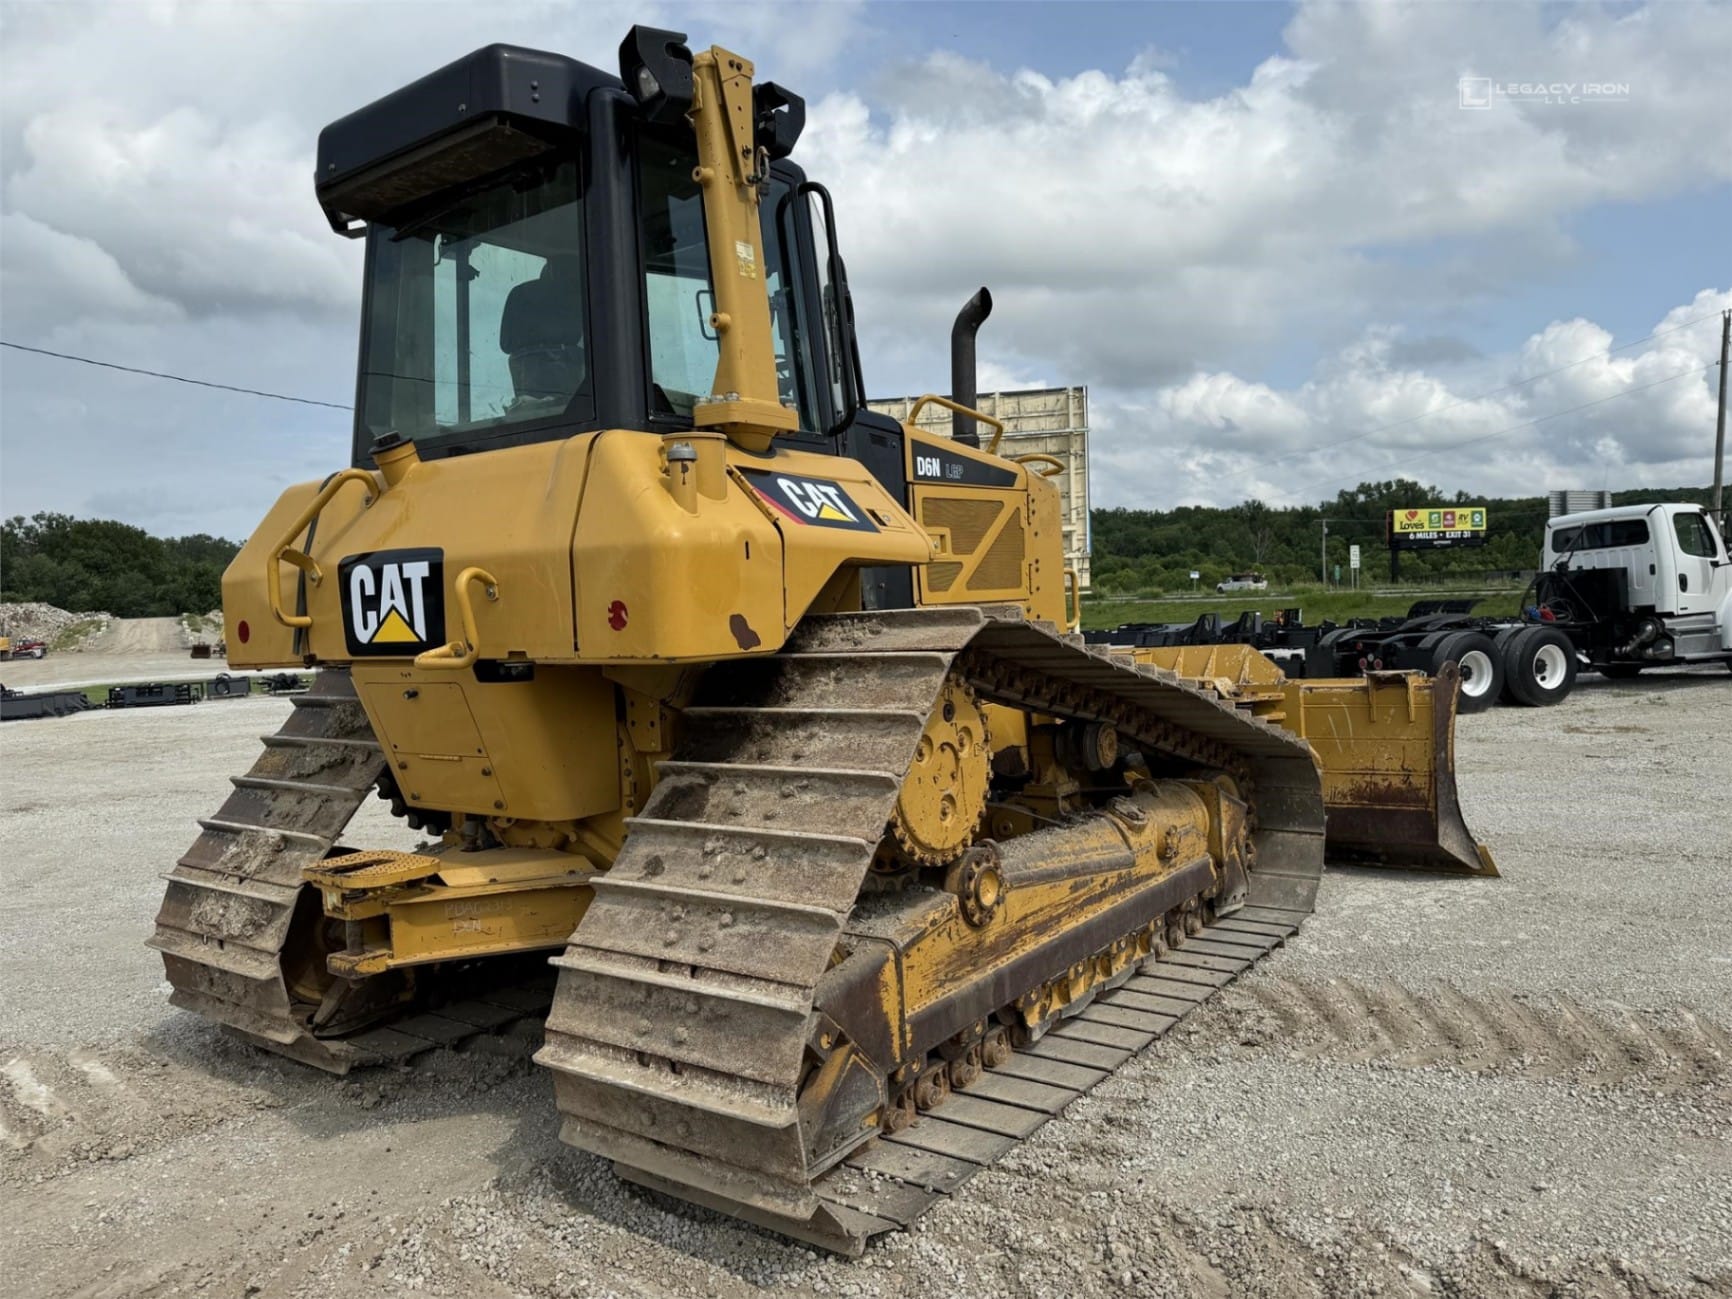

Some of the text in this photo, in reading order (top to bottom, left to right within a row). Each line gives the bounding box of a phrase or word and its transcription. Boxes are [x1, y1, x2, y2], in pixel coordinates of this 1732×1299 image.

[916, 456, 941, 477] D6N
[776, 477, 860, 524] CAT
[1409, 532, 1415, 540] 6
[1416, 531, 1438, 540] MILES
[1445, 531, 1462, 539] EXIT
[350, 560, 430, 645] CAT
